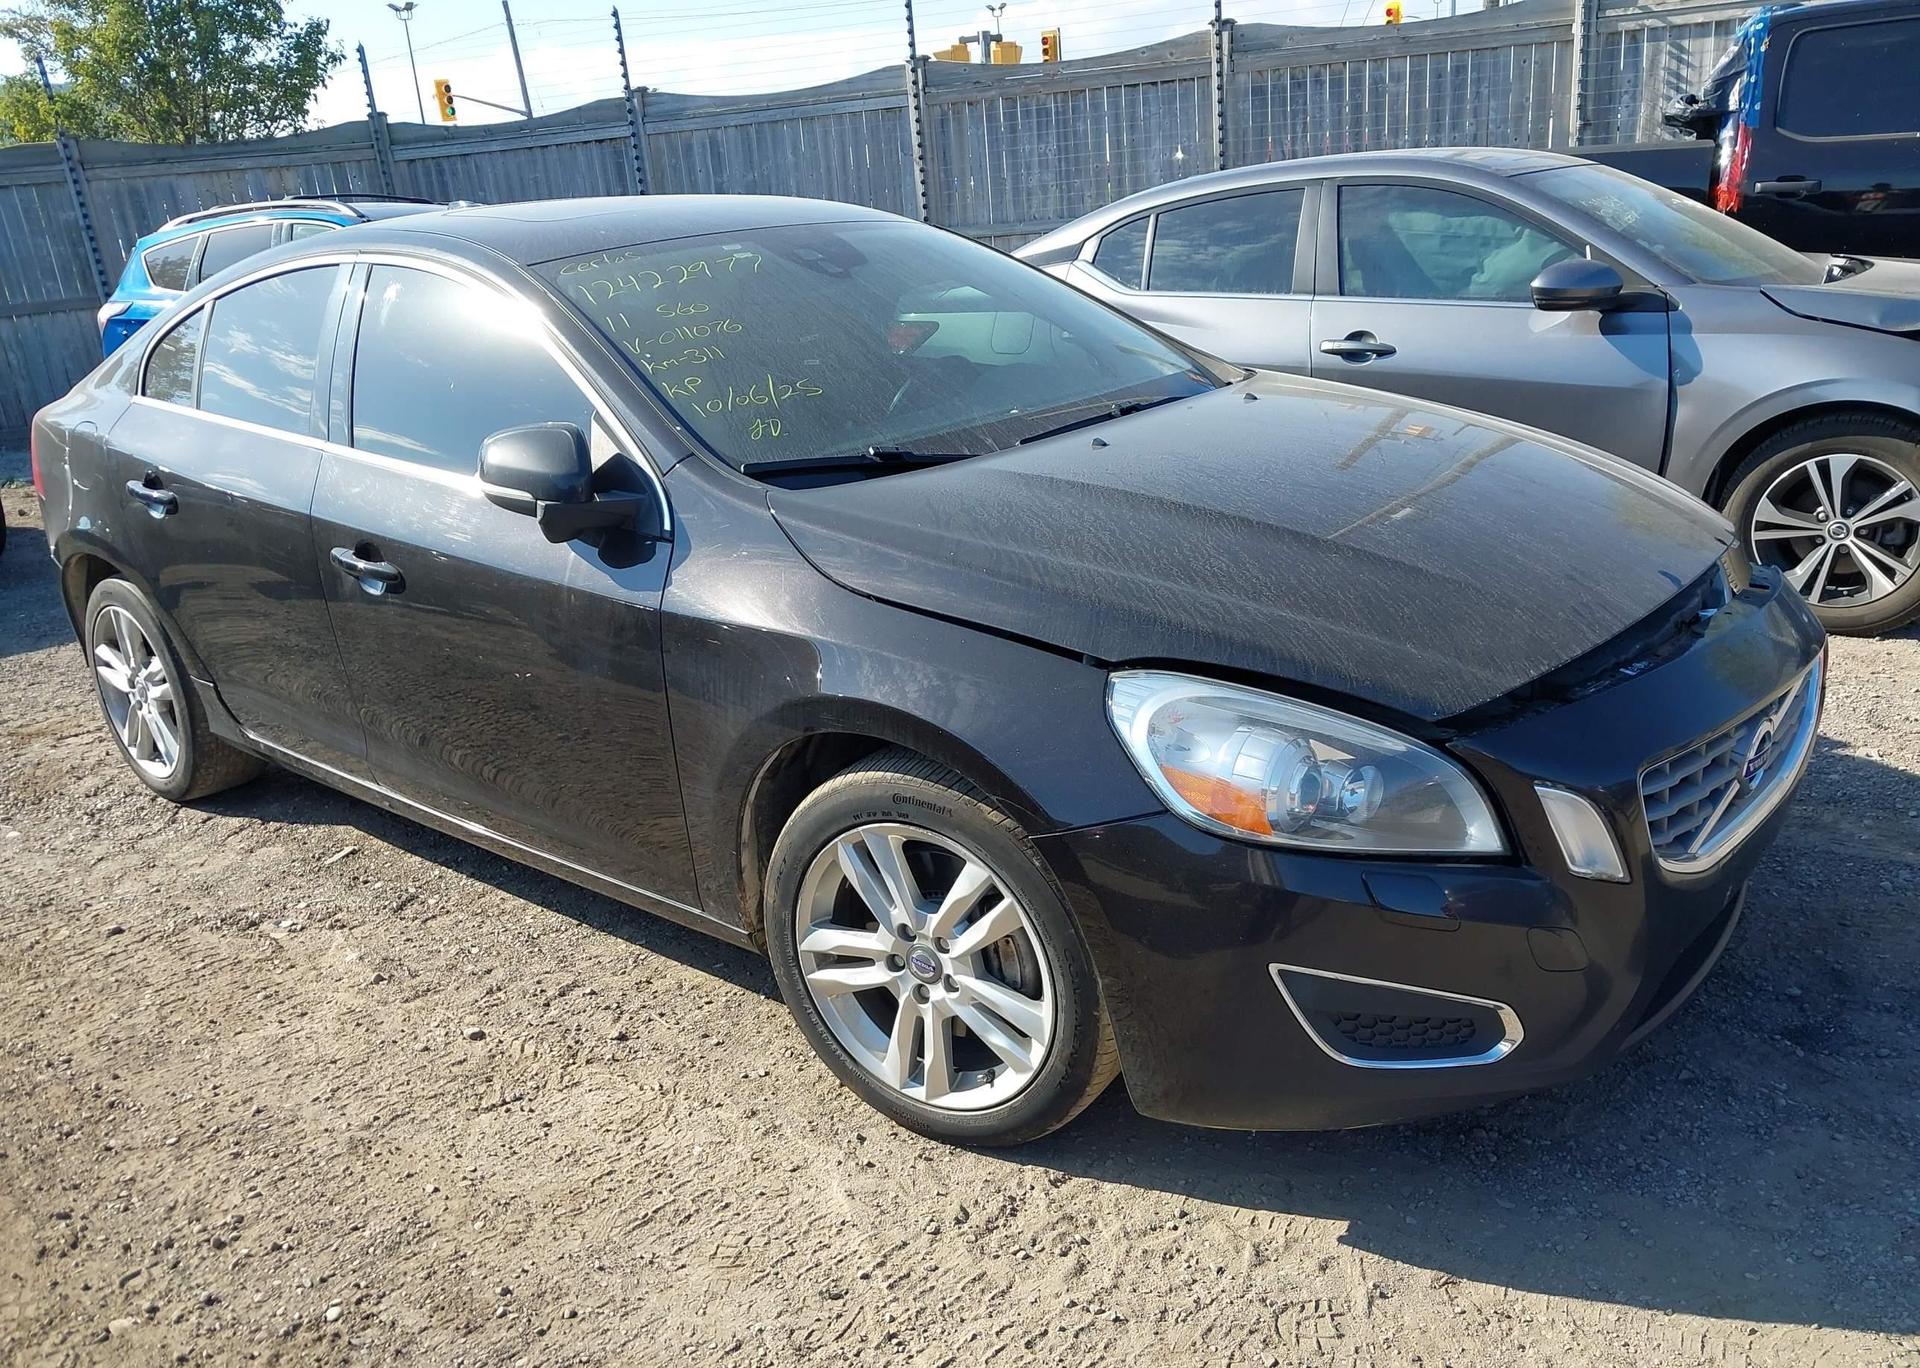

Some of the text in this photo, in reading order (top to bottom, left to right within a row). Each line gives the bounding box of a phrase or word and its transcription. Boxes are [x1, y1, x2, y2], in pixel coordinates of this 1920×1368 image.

[578, 252, 762, 305] 12422977
[691, 373, 823, 418] 10/06/25
[892, 792, 946, 816] Continental
